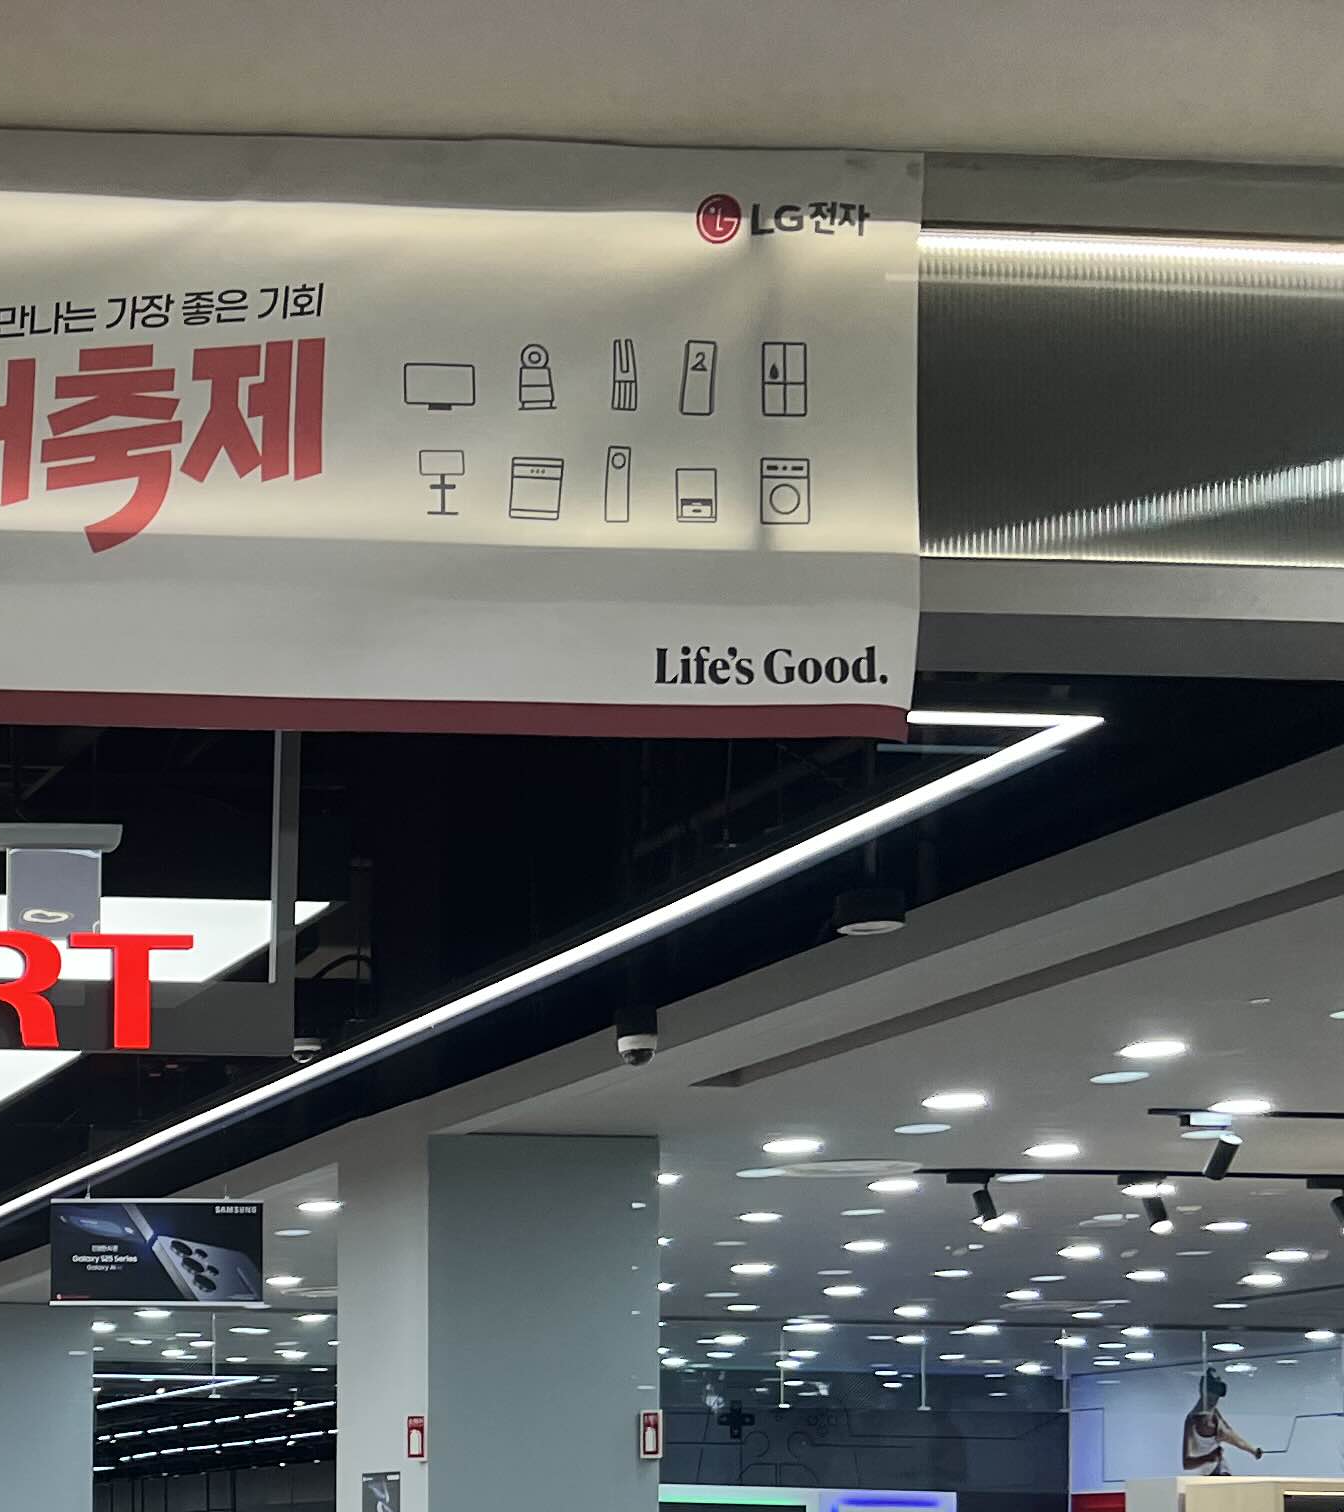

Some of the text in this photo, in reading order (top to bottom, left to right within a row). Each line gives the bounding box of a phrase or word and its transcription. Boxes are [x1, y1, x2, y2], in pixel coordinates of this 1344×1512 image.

[105, 291, 175, 332] 가장
[181, 287, 250, 327] 좋은
[258, 282, 326, 322] 기회
[654, 646, 889, 686] Life's Good.
[215, 1206, 257, 1214] SAMSUNG
